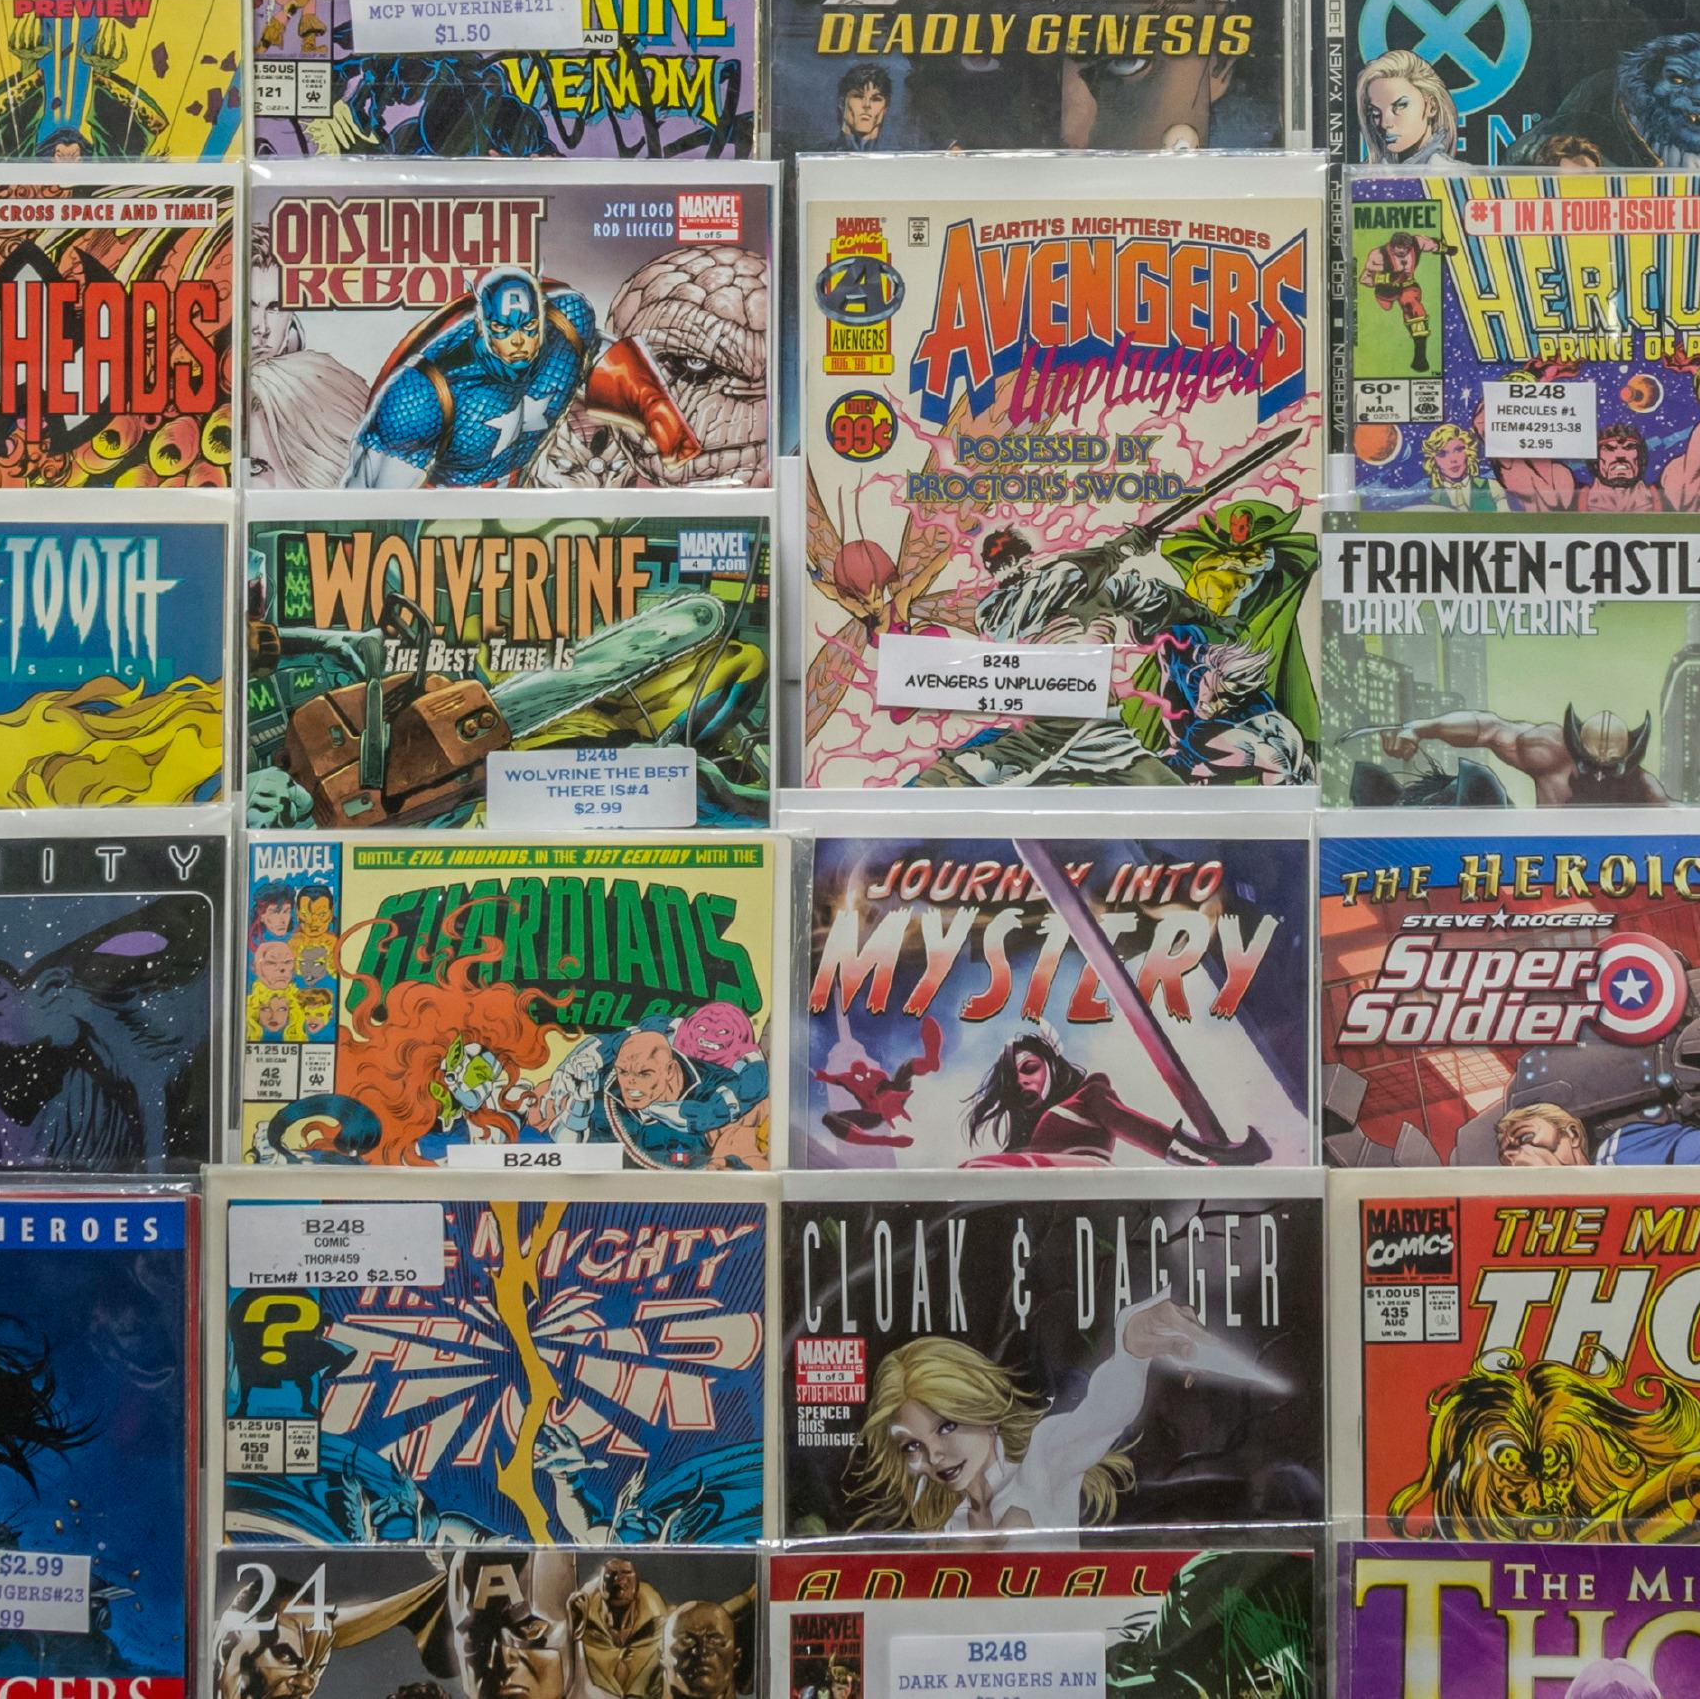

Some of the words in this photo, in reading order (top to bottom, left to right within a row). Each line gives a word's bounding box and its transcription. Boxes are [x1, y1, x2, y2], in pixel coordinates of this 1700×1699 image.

[436, 24, 490, 43] $1.50
[818, 12, 1035, 56] DEADLY
[1028, 12, 1252, 56] GENESIS
[62, 203, 116, 221] SPACE
[122, 203, 157, 220] AND
[162, 203, 214, 219] TIME!
[274, 201, 545, 262] ONSLAUGHT
[980, 220, 1066, 241] EARTH'S
[1071, 218, 1181, 237] MIGHTIEST
[1188, 222, 1271, 249] HEROES
[918, 222, 1308, 407] AVENGERS
[1509, 385, 1564, 399] B248
[1497, 405, 1557, 416] HERCULES
[1562, 405, 1576, 415] #1
[1342, 600, 1423, 635] DARK
[1439, 600, 1599, 636] WOLVERINE
[983, 655, 1020, 669] B248
[904, 676, 988, 691] AVENGERS
[994, 678, 1097, 693] UNPLUGGED6
[977, 697, 1023, 712] $1.95
[573, 802, 622, 815] $2.99
[1402, 913, 1487, 928] STEVE
[1507, 913, 1614, 928] ROGERS
[1382, 934, 1597, 989] Super-
[1339, 996, 1594, 1045] Soldier
[306, 1219, 364, 1234] B248
[1495, 1208, 1605, 1254] THE
[304, 1253, 360, 1264] THOR#459
[0, 1554, 63, 1577] $2.99
